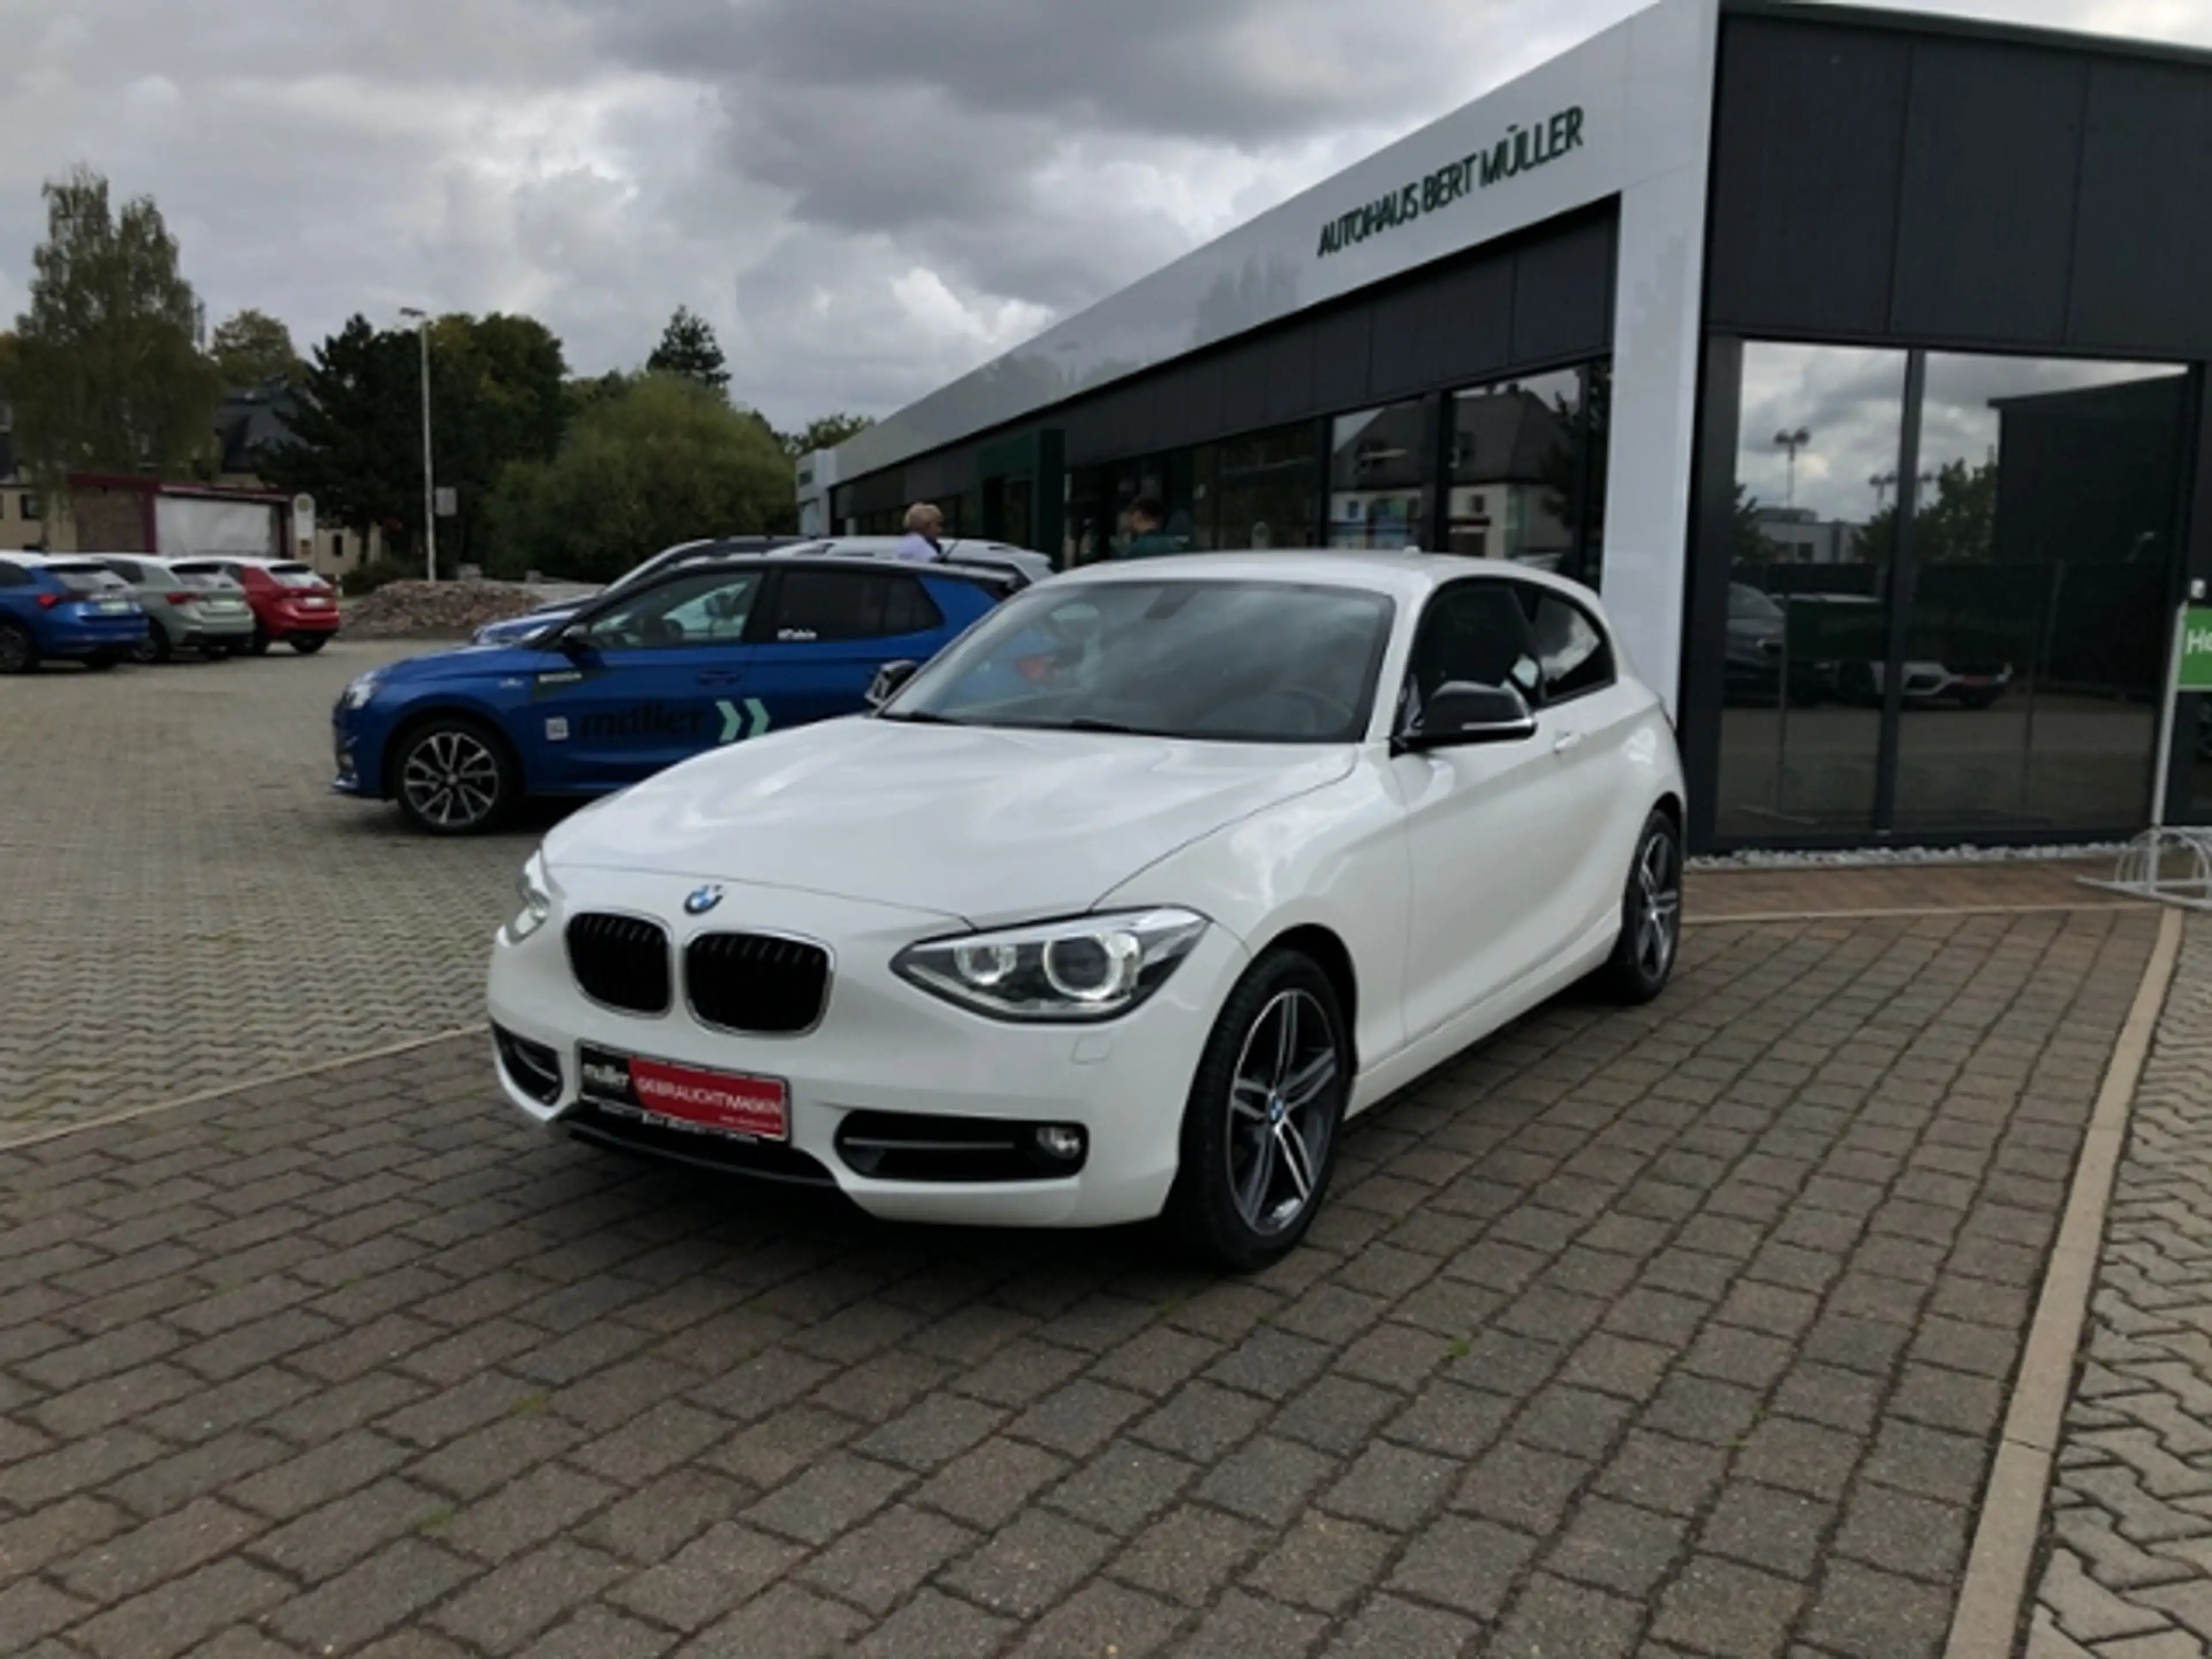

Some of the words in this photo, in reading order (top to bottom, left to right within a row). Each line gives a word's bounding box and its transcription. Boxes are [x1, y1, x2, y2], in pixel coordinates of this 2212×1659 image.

[1317, 181, 1419, 257] AUTOHAUS
[1422, 153, 1478, 213] BERT
[1479, 106, 1584, 188] MÜLLER
